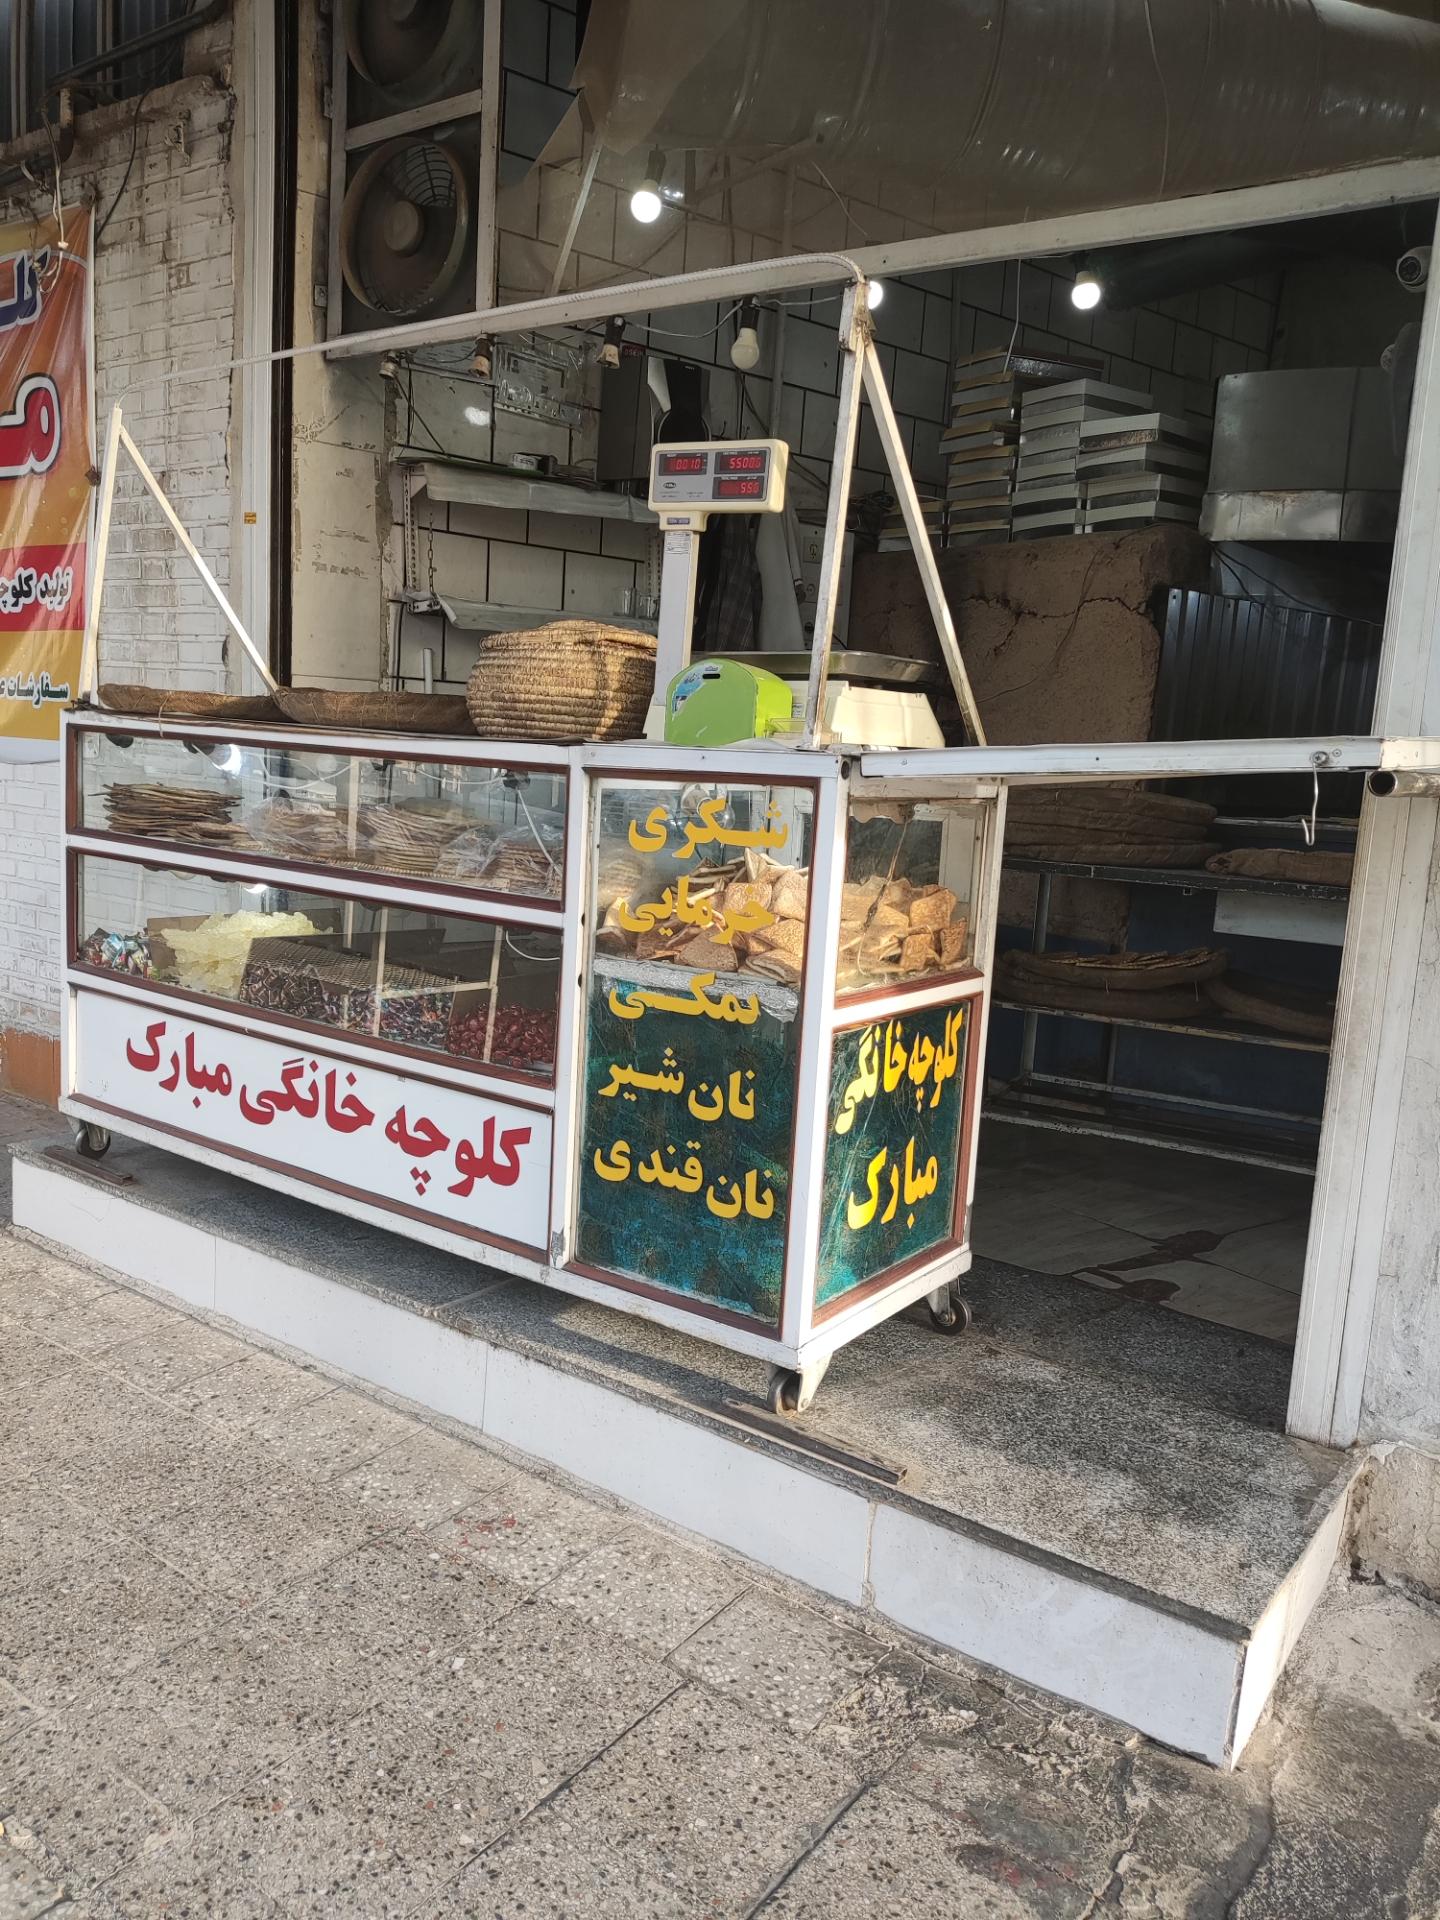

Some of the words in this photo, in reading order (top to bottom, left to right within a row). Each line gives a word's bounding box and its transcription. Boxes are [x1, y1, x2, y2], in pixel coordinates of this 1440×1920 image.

[39, 571, 71, 606] تولید
[628, 798, 789, 859] شکری
[618, 874, 778, 944] خرمایی
[126, 1021, 233, 1109] مبارک
[239, 1057, 376, 1134] خانگی
[597, 1046, 685, 1102] شیر
[687, 1069, 756, 1122] نان
[834, 1019, 908, 1136] خانگی
[907, 1007, 963, 1115] کلوچه
[384, 1104, 532, 1198] کلوچه
[593, 1139, 704, 1194] قندی
[846, 1135, 939, 1231] مبارک
[705, 1168, 775, 1220] نان
